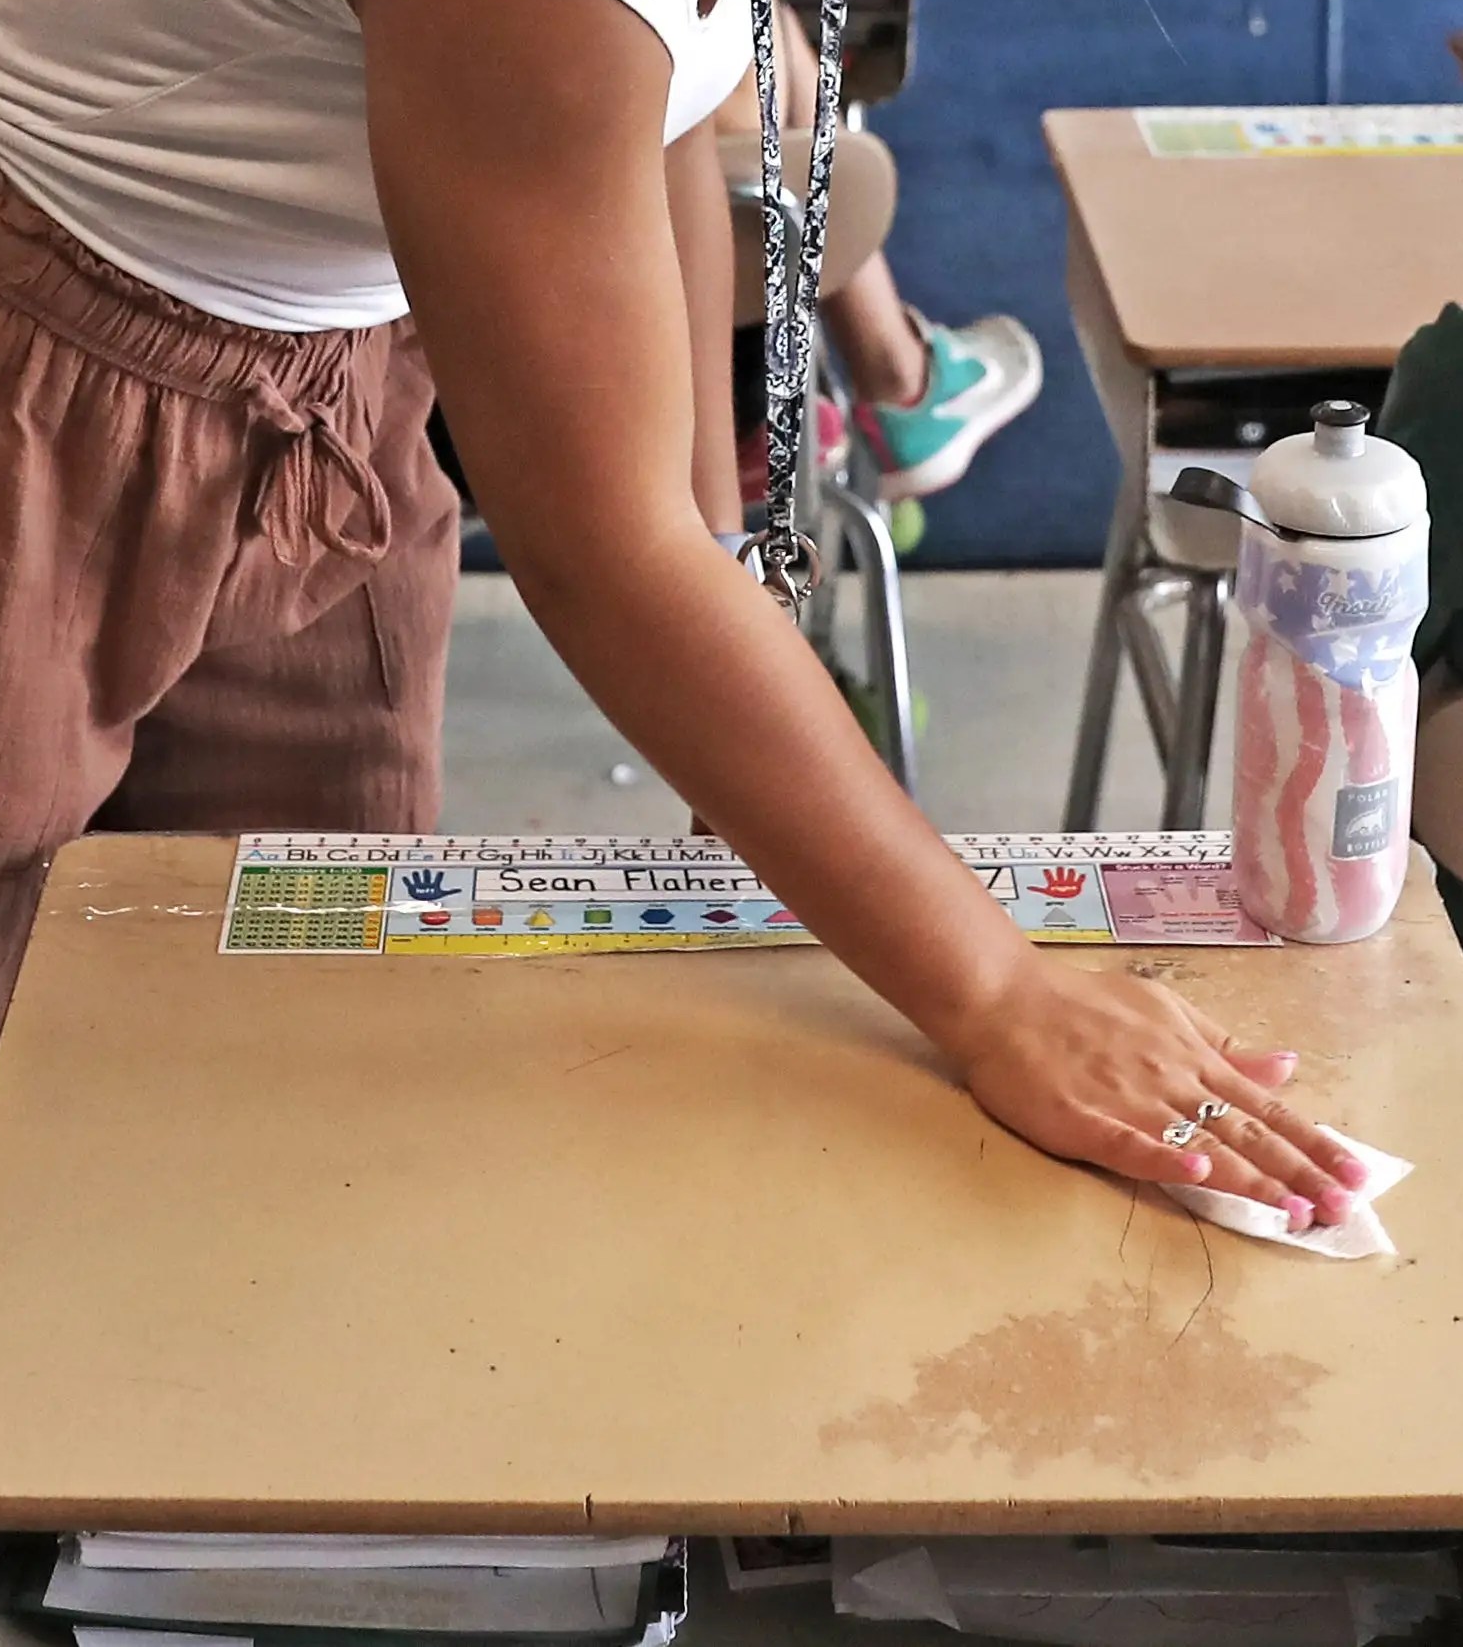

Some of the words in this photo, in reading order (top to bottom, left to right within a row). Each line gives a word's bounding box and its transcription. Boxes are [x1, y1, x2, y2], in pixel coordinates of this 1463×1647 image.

[1347, 788, 1389, 803] POLAR
[1346, 837, 1388, 853] BOTTLE
[244, 850, 280, 861] Aa
[286, 850, 319, 861] Bb
[327, 850, 360, 861] Cc
[367, 850, 401, 861] Dd
[406, 850, 434, 861] Ee
[443, 850, 473, 861] Ff
[476, 849, 513, 866] Gg
[521, 850, 553, 861] Hh
[582, 849, 606, 865] Jj
[613, 849, 644, 861] Kk
[651, 849, 672, 861] Ll
[680, 849, 723, 861] Mm
[972, 847, 1001, 859] Tt
[1046, 847, 1074, 858] Vv
[1081, 846, 1132, 858] Ww
[1139, 846, 1173, 857] Xx
[1179, 844, 1208, 861] Yy
[1217, 844, 1231, 856] Z
[269, 866, 327, 875] Numbers
[1115, 863, 1152, 871] Stuck
[1185, 863, 1228, 871] Word?
[499, 868, 597, 892] Sean
[1049, 884, 1078, 893] right
